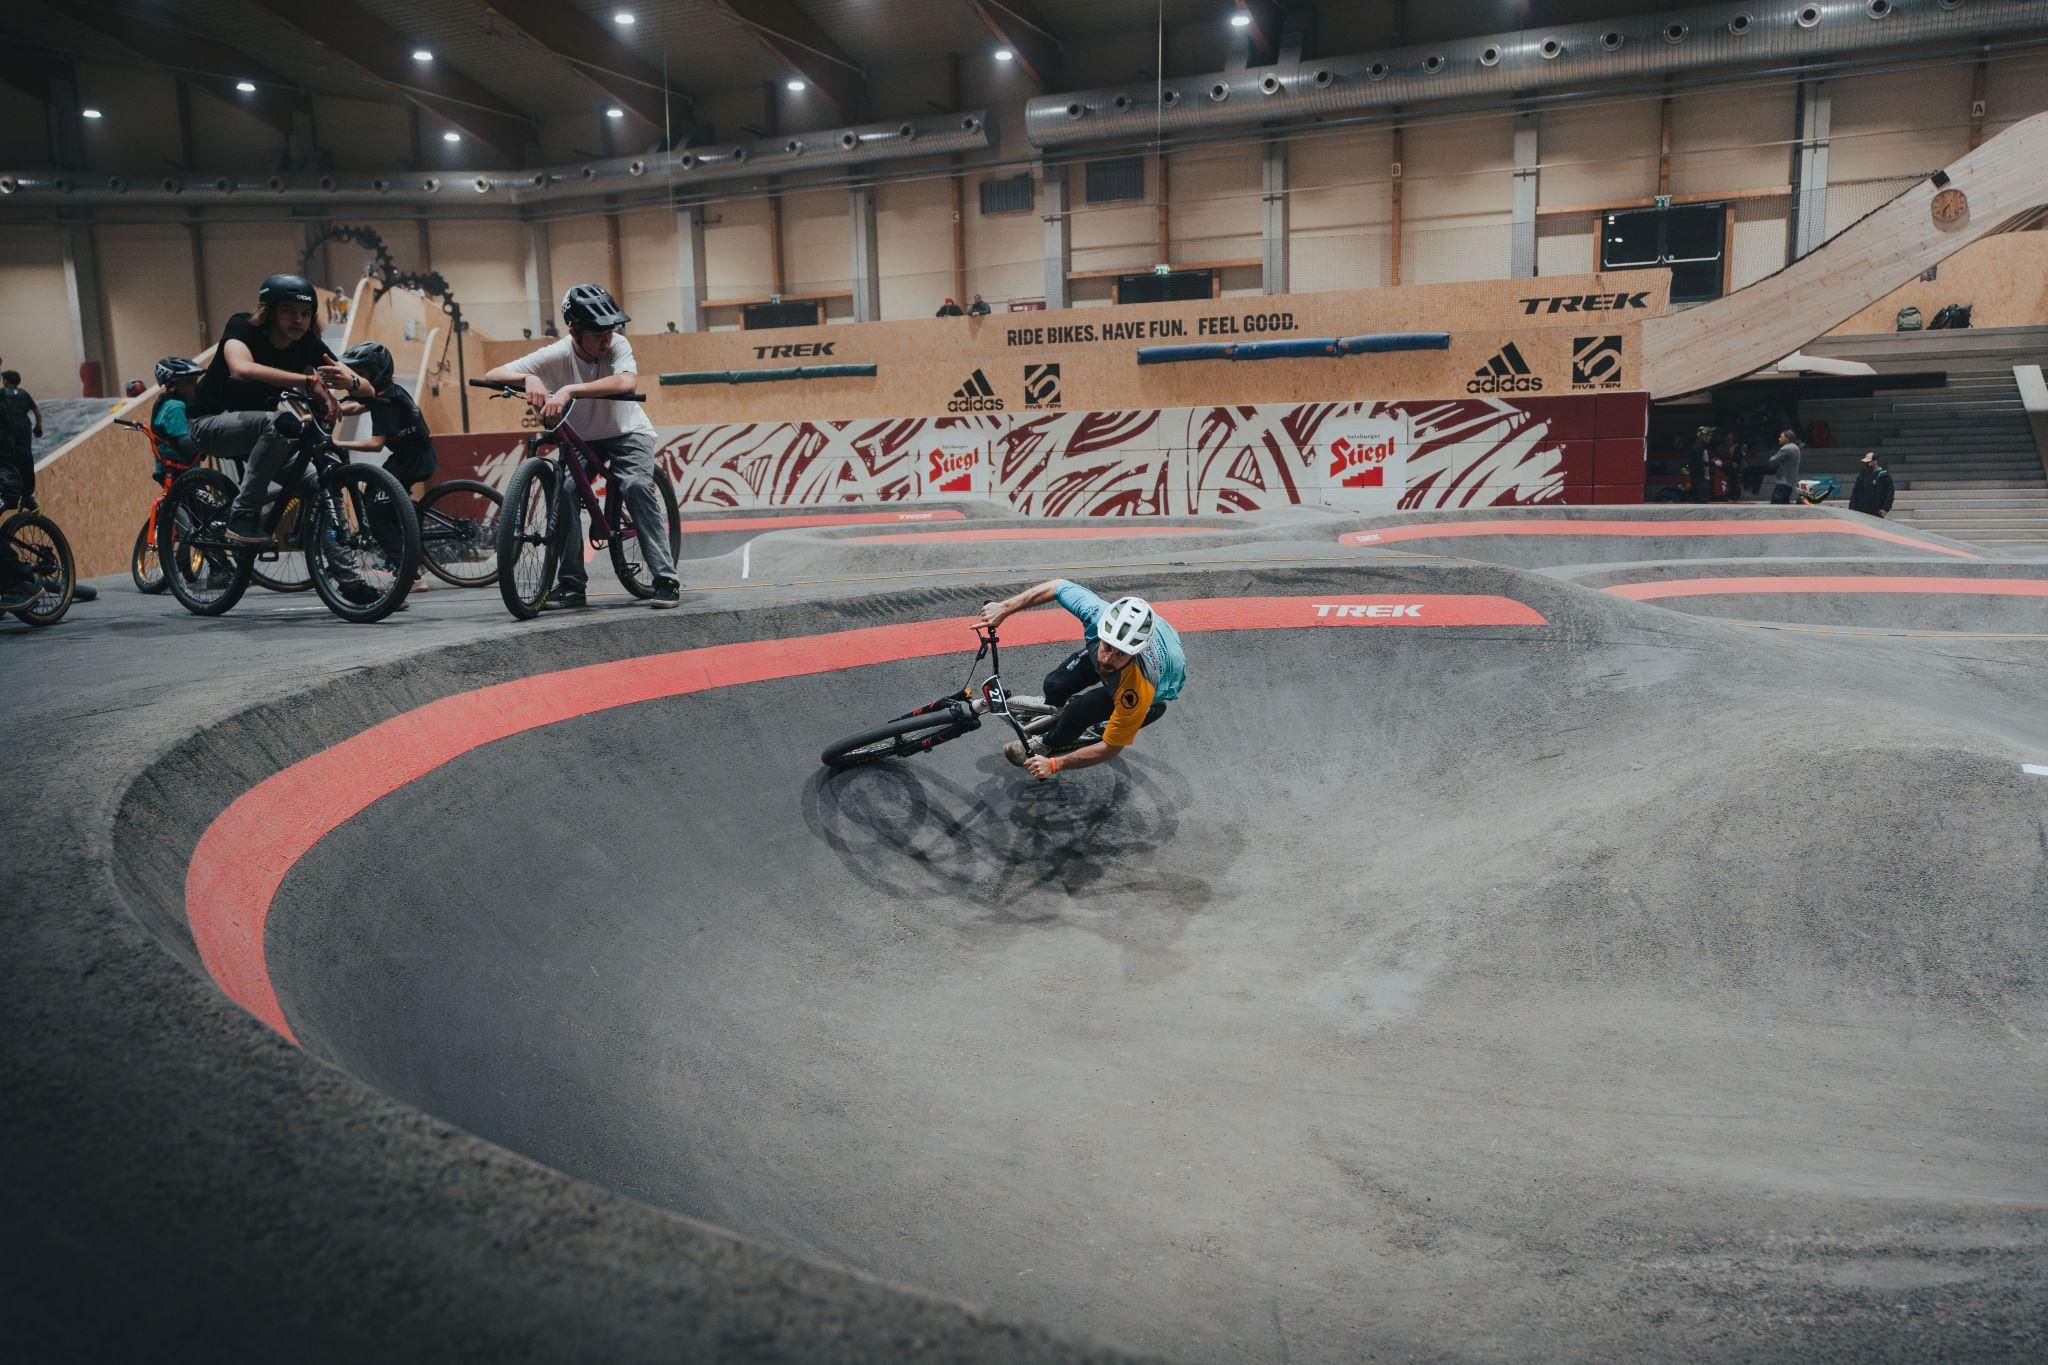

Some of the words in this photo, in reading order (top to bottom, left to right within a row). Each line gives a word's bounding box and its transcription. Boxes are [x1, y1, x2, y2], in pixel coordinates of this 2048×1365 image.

[1518, 291, 1653, 315] TREK
[1007, 327, 1043, 346] RIDE
[1047, 324, 1099, 344] BIKES.
[1102, 321, 1146, 340] HAVE
[1149, 318, 1188, 338] FUN.
[1198, 316, 1240, 335] FEEL
[1243, 312, 1299, 333] GOOD.
[752, 342, 837, 360] TREK
[1466, 374, 1543, 394] adidas
[947, 396, 1004, 412] adidas
[929, 447, 979, 483] Stiegl
[1330, 436, 1395, 478] Stiegl
[1311, 604, 1425, 618] TREK
[989, 688, 1003, 703] 27
